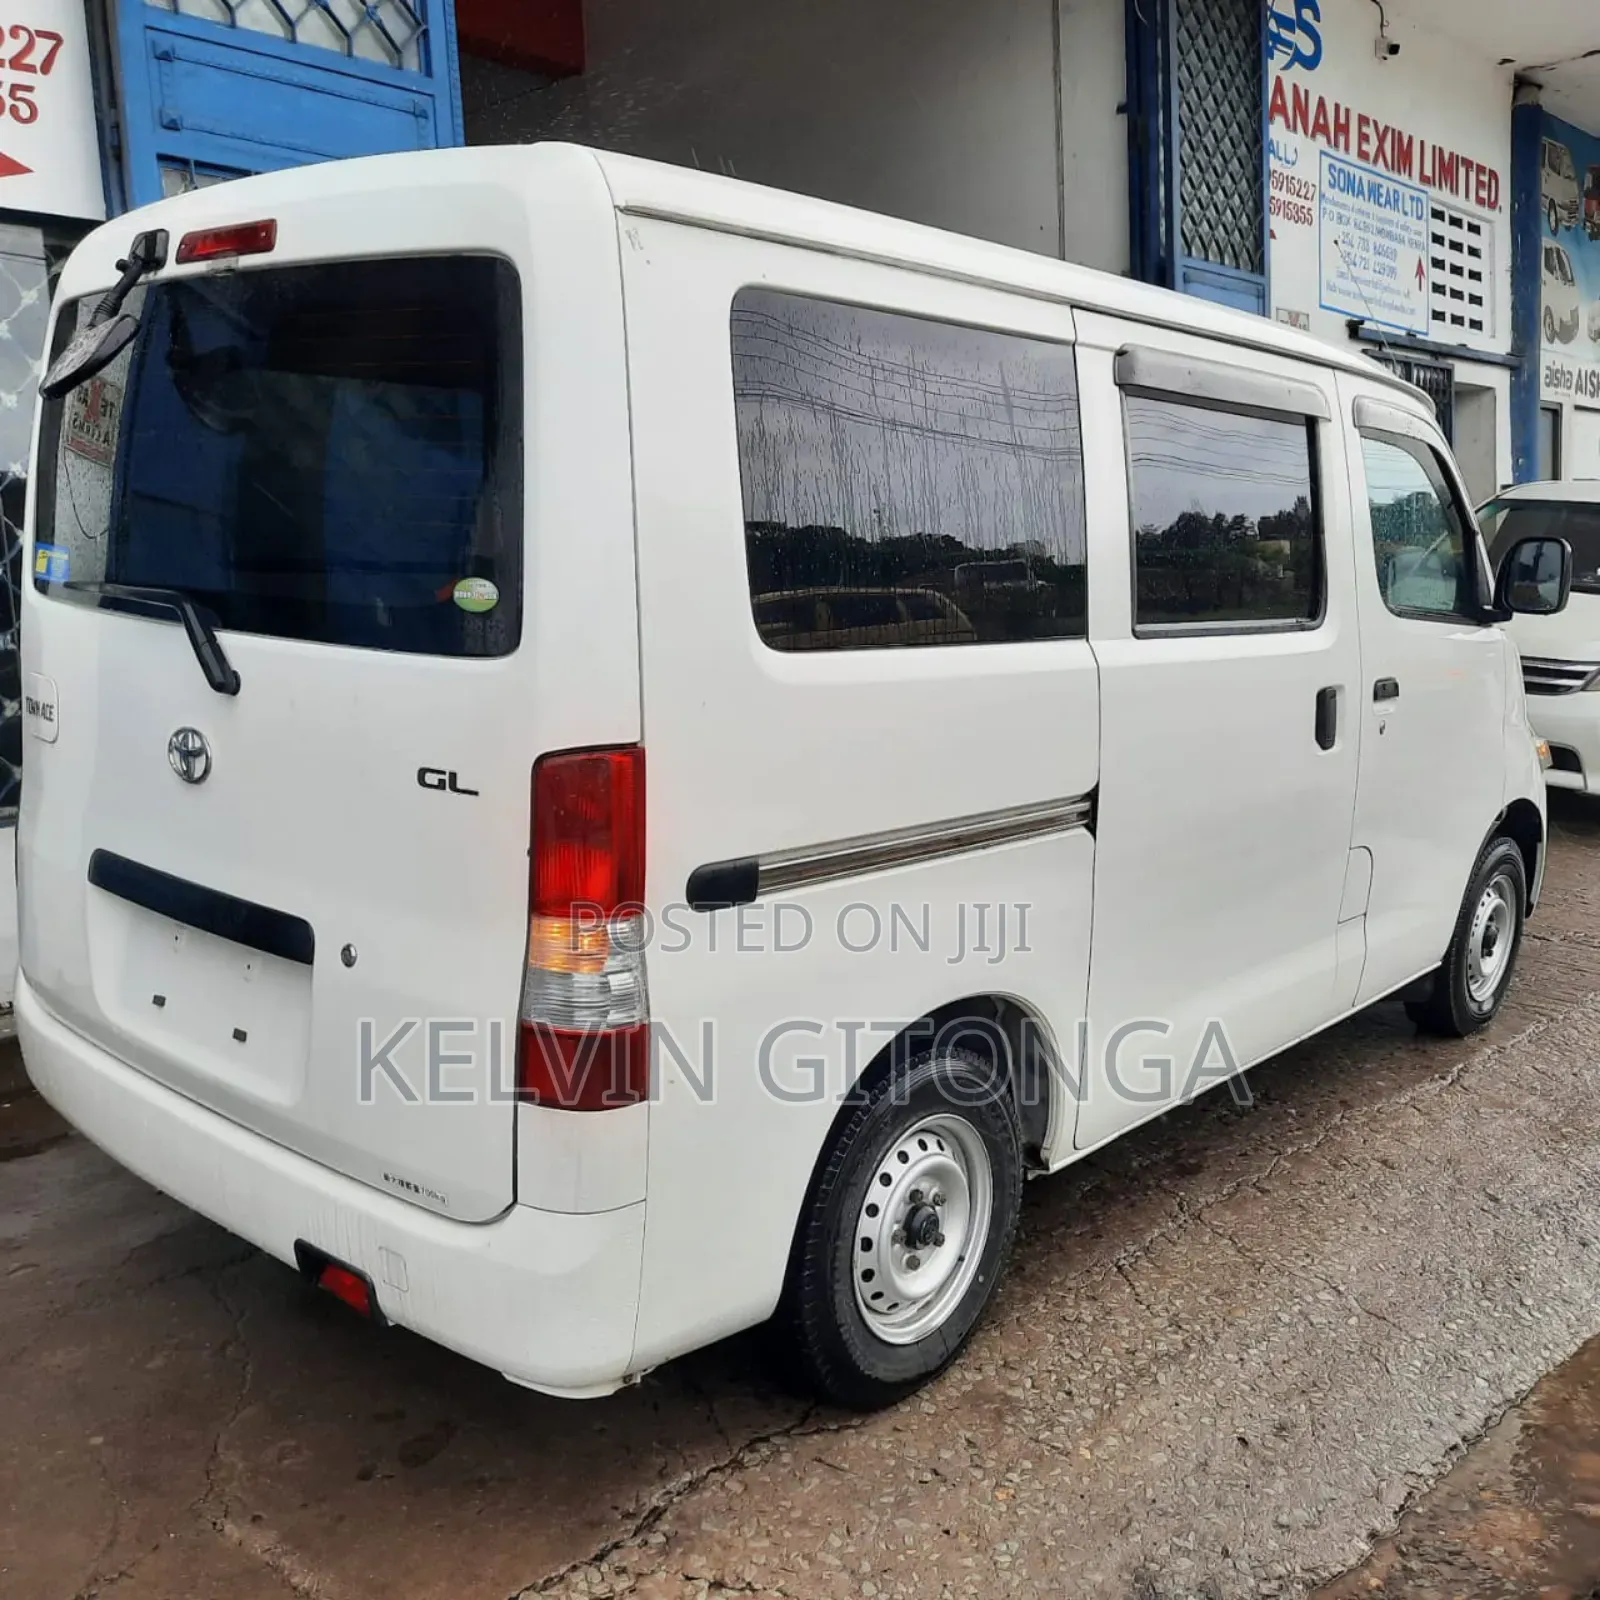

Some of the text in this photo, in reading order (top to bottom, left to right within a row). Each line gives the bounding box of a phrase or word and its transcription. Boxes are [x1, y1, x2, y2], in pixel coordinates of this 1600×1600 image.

[0, 24, 64, 76] 27
[0, 82, 38, 124] 5
[1269, 75, 1502, 213] ANAH EXIM LIMITED.
[1269, 169, 1317, 202] 5915227
[1328, 163, 1366, 202] SONA
[1367, 179, 1400, 213] WEAR
[1402, 191, 1424, 220] LTD
[417, 766, 479, 797] GL
